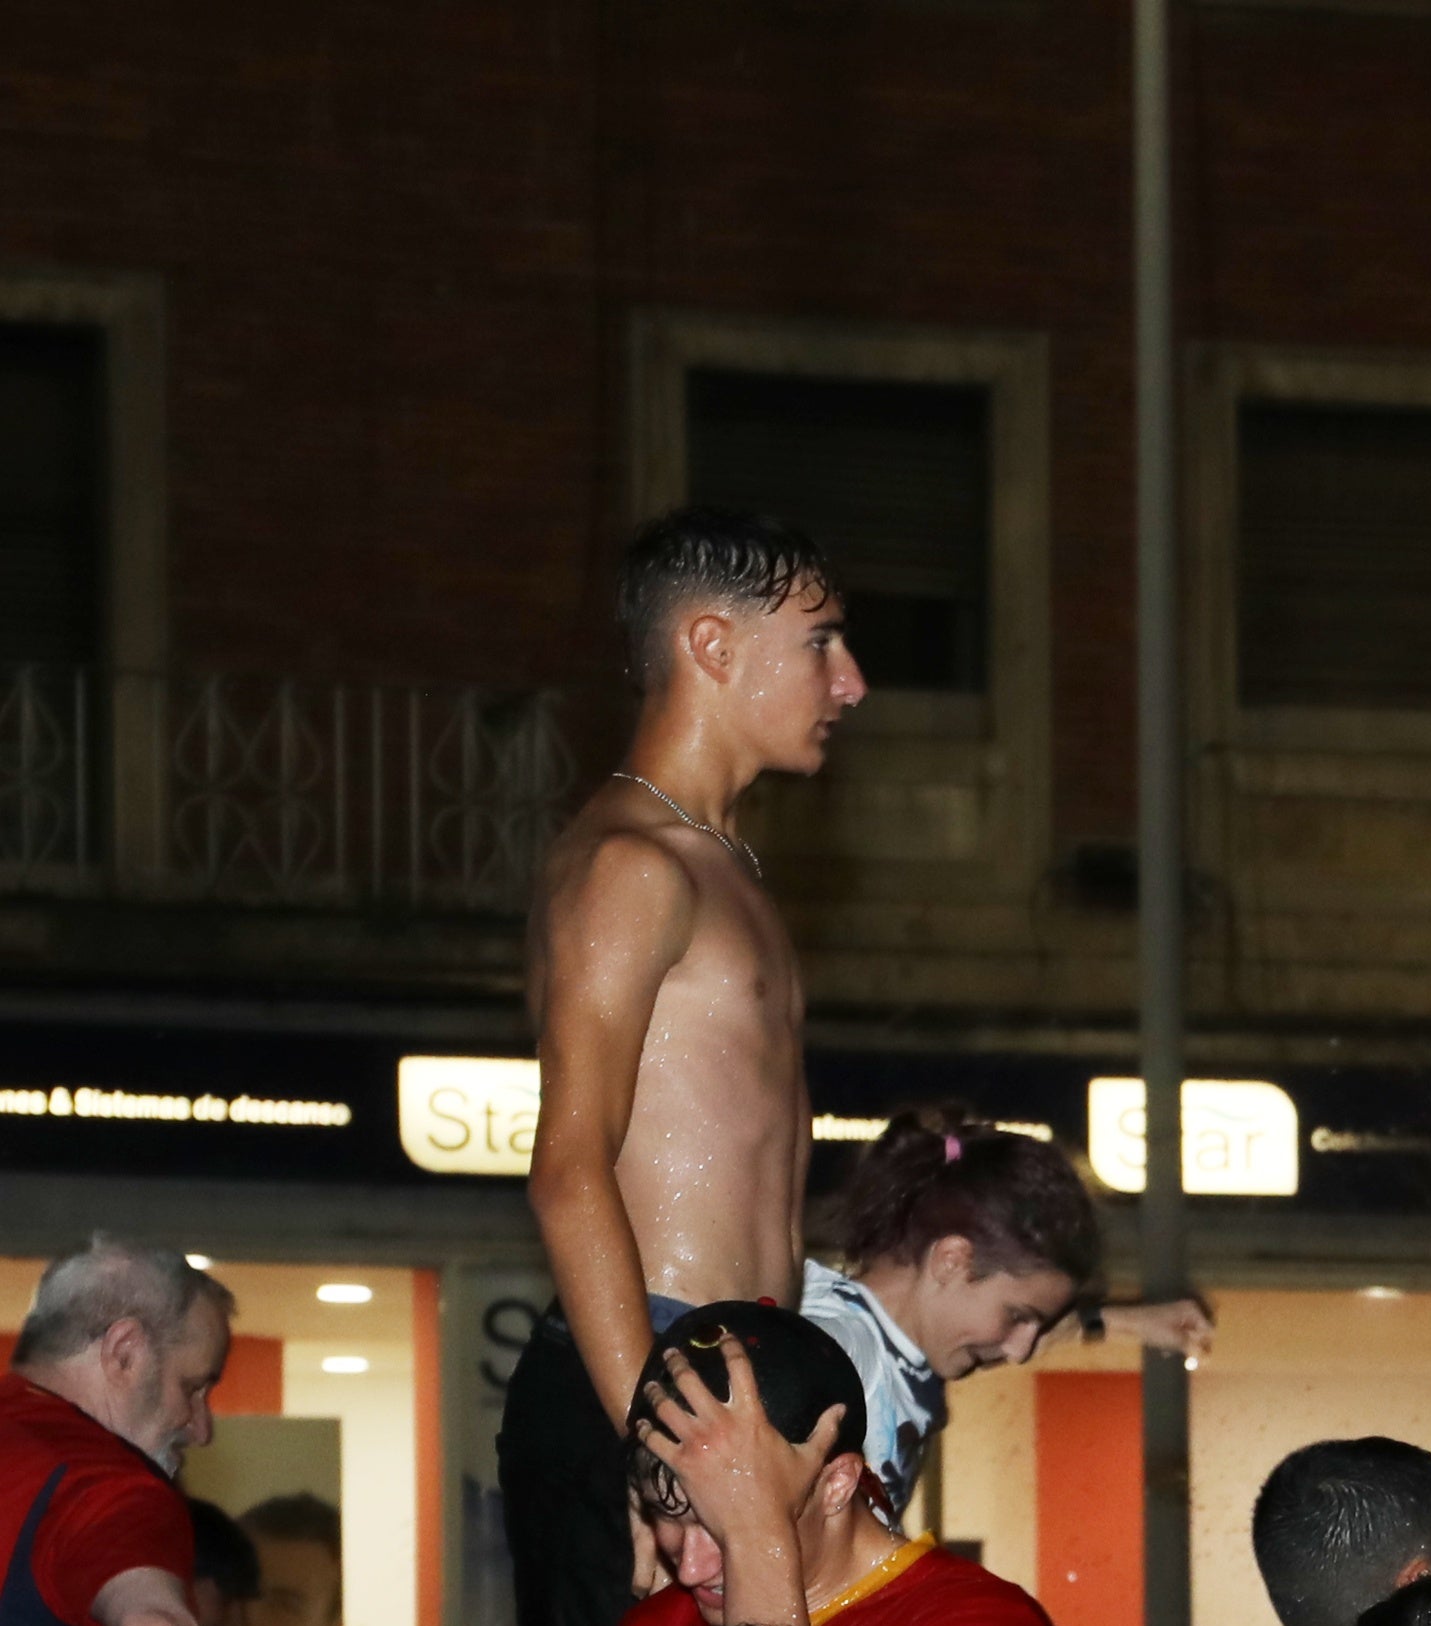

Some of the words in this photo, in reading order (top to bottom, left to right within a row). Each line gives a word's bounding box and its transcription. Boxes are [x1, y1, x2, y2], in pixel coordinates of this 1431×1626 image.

[192, 1092, 229, 1122] de
[229, 1094, 354, 1127] descanso
[427, 1086, 538, 1155] Sta
[1118, 1105, 1266, 1171] Sar
